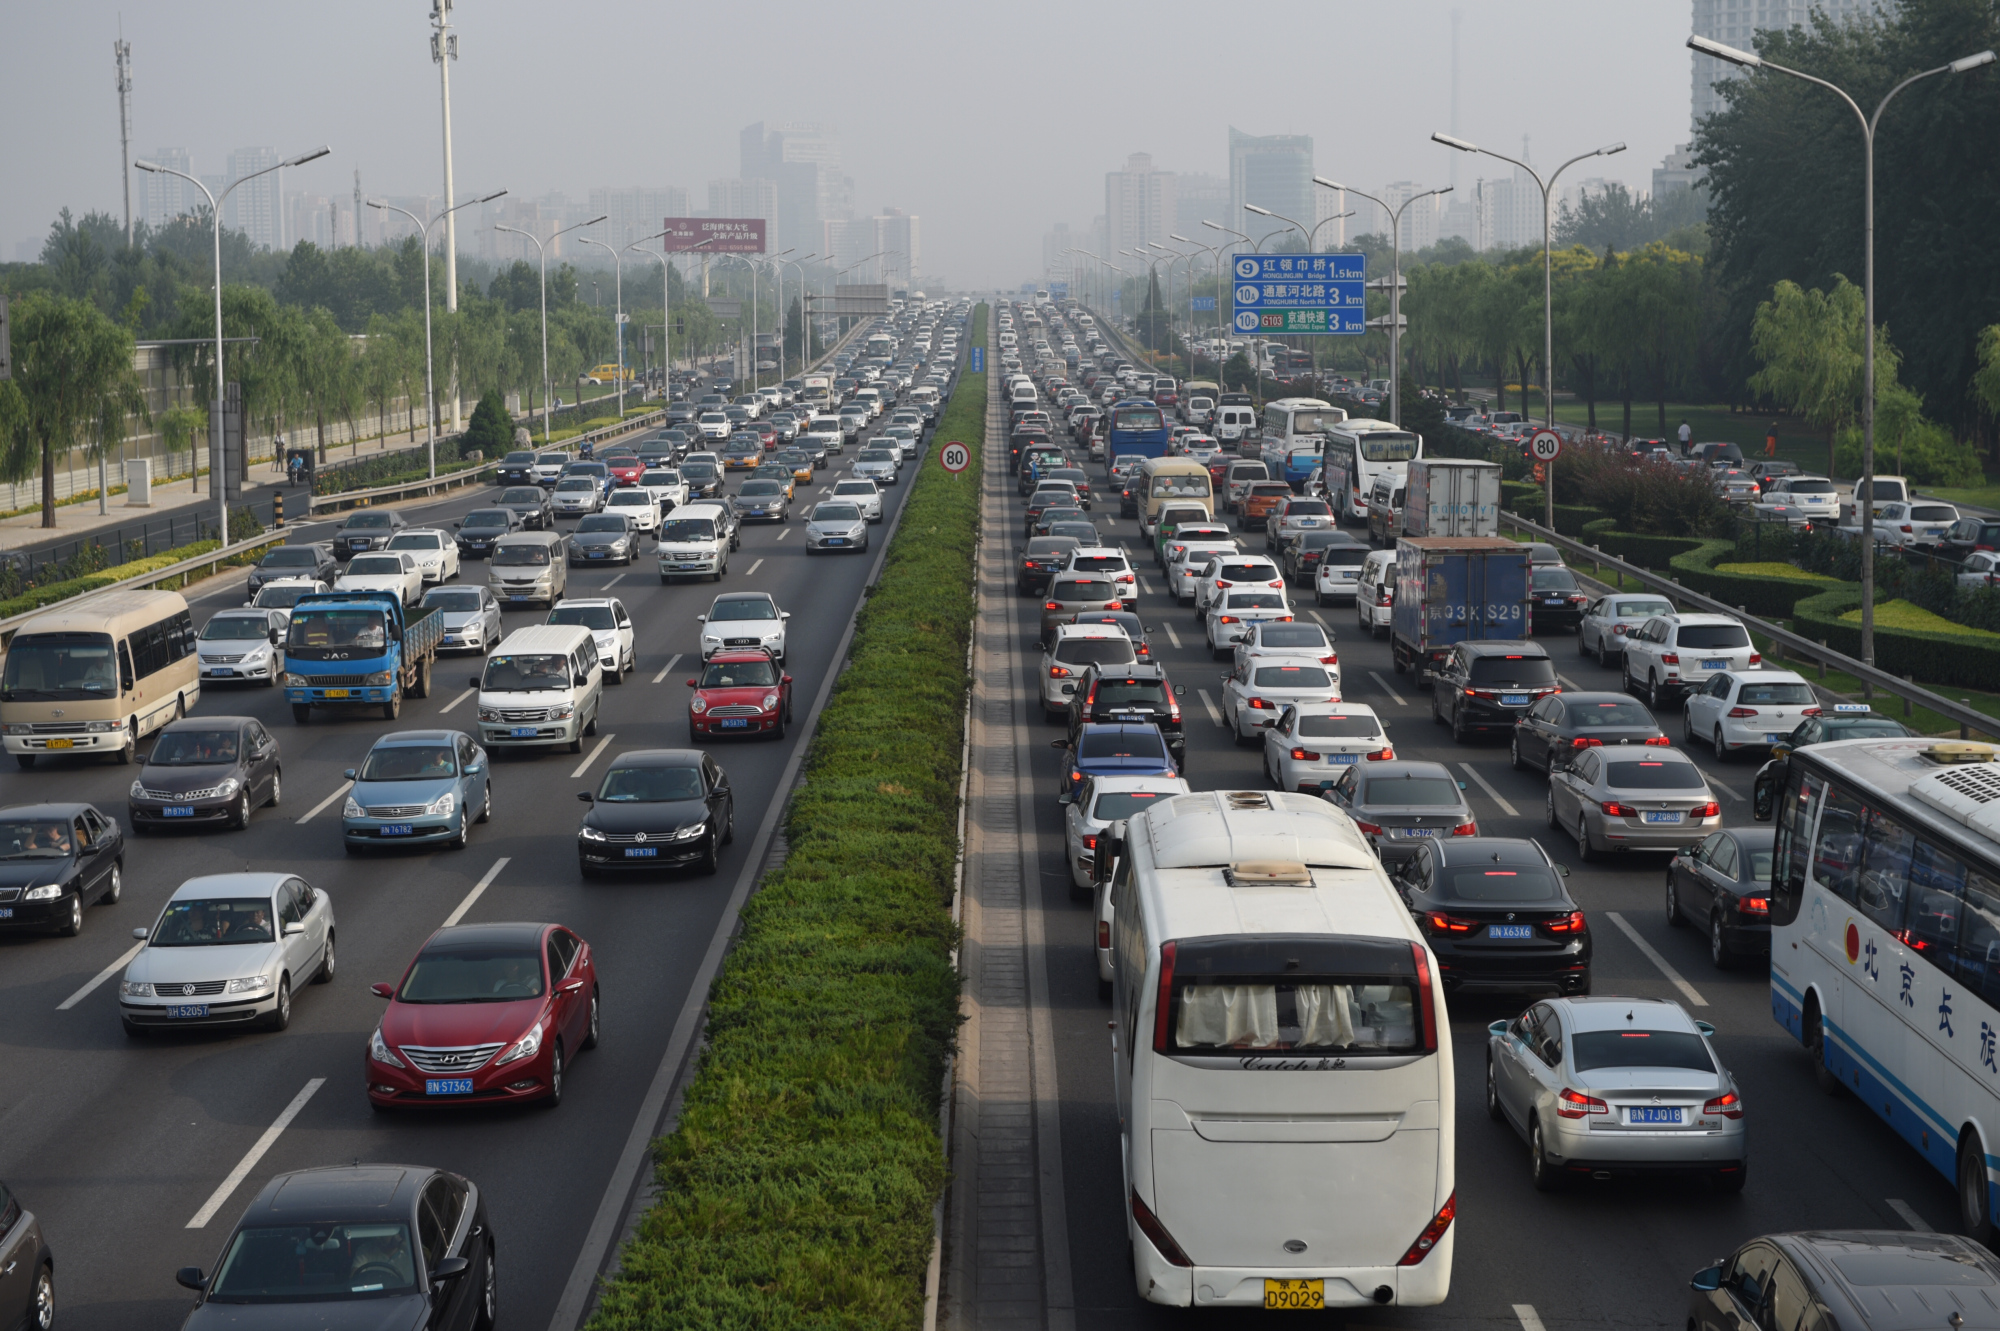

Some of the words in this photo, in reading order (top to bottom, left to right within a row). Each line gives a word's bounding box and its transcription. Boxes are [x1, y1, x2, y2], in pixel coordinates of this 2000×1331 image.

[1242, 262, 1254, 275] 9
[1263, 259, 1326, 271] 红领巾桥
[1307, 272, 1326, 280] Bridge
[1239, 289, 1256, 301] 10A
[1263, 285, 1326, 297] 通惠河北路
[1329, 288, 1340, 304] 3
[1346, 295, 1362, 305] km
[1239, 314, 1256, 327] 10B
[1262, 316, 1283, 326] G103
[1287, 311, 1326, 323] 京通快速
[1329, 314, 1340, 330] 3
[1346, 321, 1362, 331] km
[1537, 439, 1555, 455] 80
[946, 450, 964, 465] 80
[322, 652, 350, 660] JAC
[1864, 938, 1998, 1074] 北京长旅
[1239, 1057, 1309, 1071] Catch
[1267, 1291, 1322, 1307] D9029
